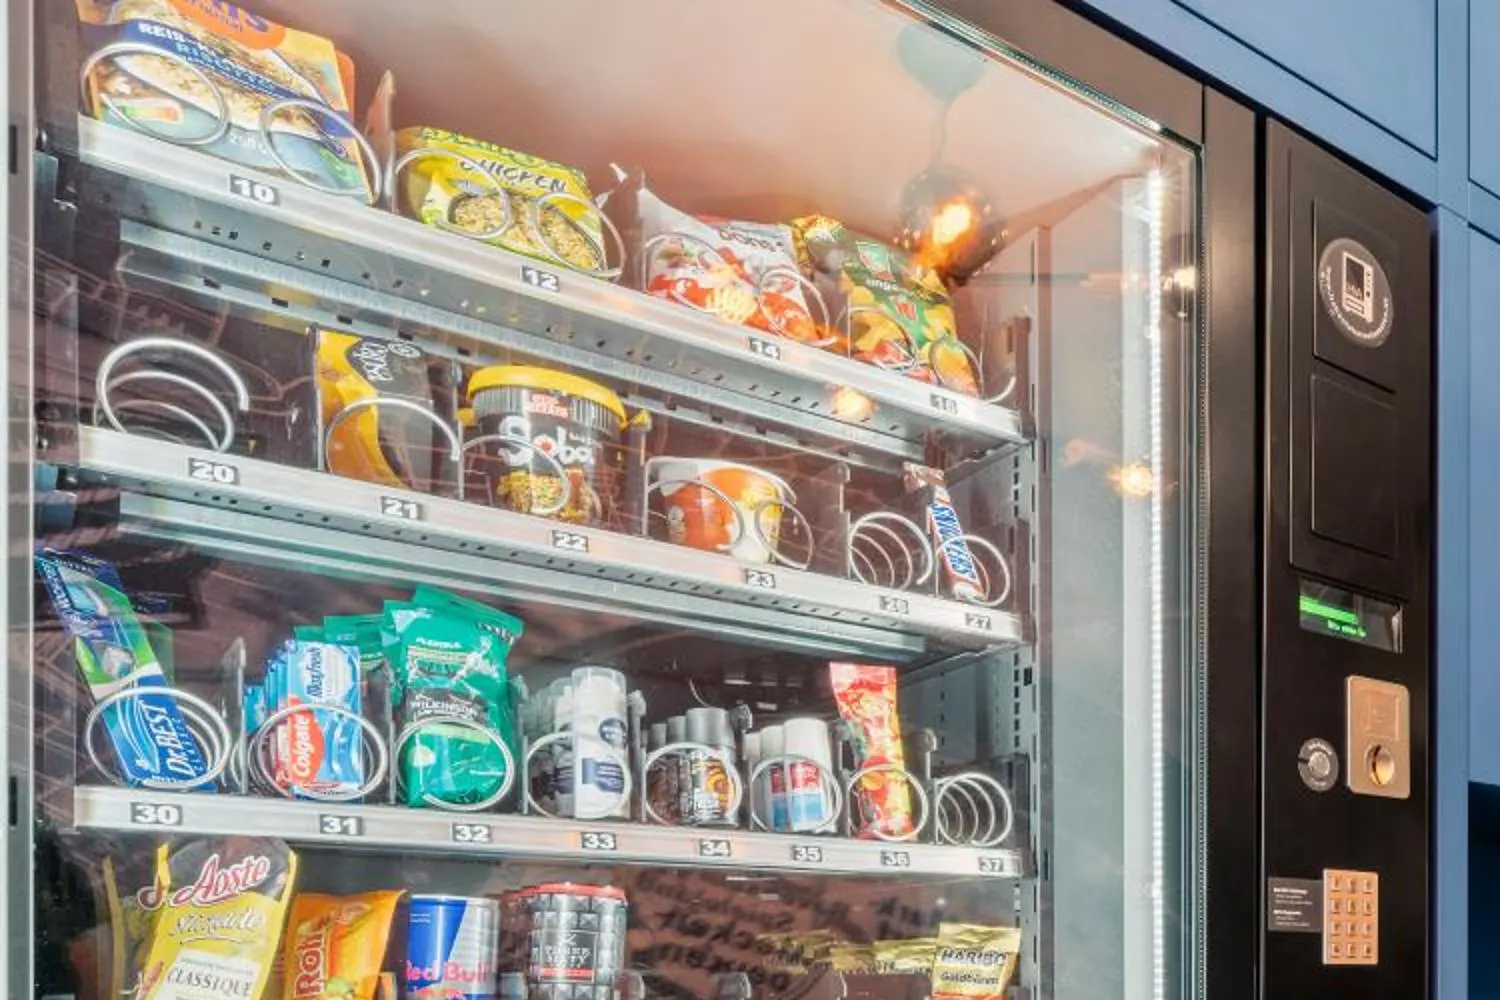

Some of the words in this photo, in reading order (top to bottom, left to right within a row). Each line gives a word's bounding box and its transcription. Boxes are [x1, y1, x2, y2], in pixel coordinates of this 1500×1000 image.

[233, 178, 275, 203] 10
[525, 266, 560, 292] 12
[752, 340, 779, 358] 14
[190, 460, 233, 483] 20
[384, 499, 417, 520] 21
[555, 533, 587, 551] 22
[291, 714, 315, 779] Colgate
[137, 806, 180, 827] 30
[322, 817, 360, 834] 31
[454, 825, 489, 842] 32
[583, 833, 616, 850] 33
[702, 841, 730, 857] 34
[794, 848, 822, 863] 35
[884, 854, 910, 868] 36
[980, 860, 1004, 874] 37
[170, 853, 271, 906] Aoste
[940, 948, 1007, 965] HARIBO
[444, 960, 488, 983] Bull
[167, 966, 253, 998] CLASSIQUE
